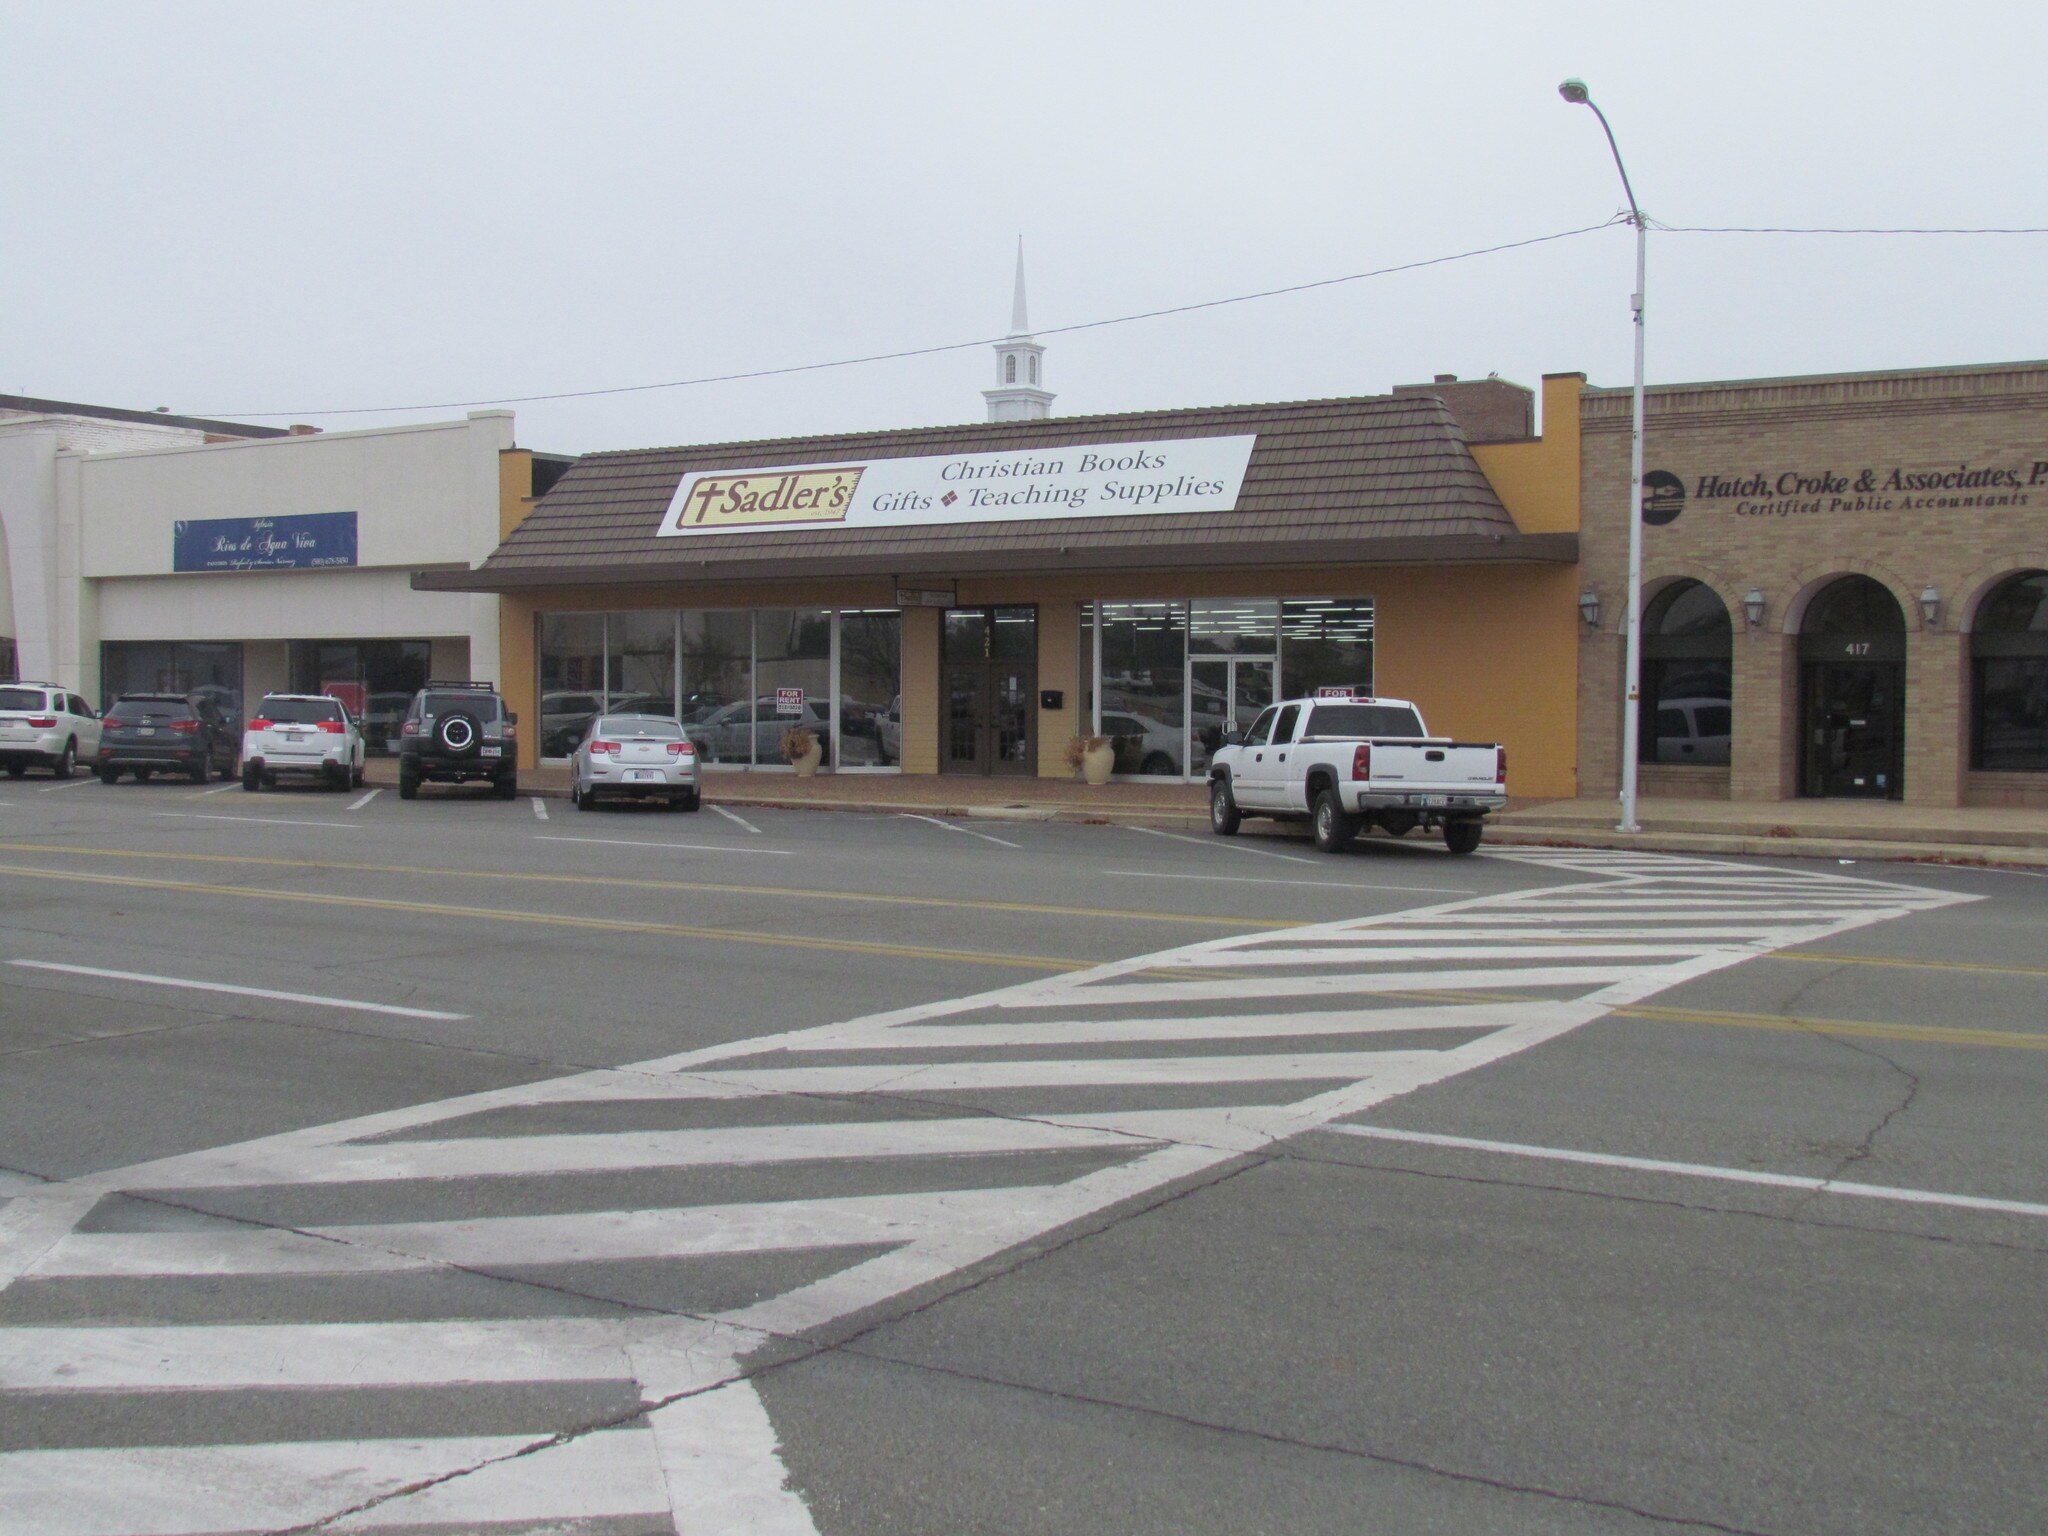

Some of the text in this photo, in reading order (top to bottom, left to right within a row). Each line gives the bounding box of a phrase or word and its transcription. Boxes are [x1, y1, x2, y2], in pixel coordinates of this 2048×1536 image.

[941, 450, 1166, 481] Christian Books
[719, 475, 848, 513] Sadler's
[872, 476, 1224, 511] Gifts Teaching Supplies
[1695, 473, 1774, 499] Hatch,
[1776, 470, 1848, 496] Croke
[1854, 469, 1876, 493] &
[1883, 465, 2023, 491] Associates,
[1736, 492, 2029, 517] Certified Public Accountants
[240, 536, 252, 551] de
[292, 531, 316, 549] Viva
[1845, 643, 1870, 655] 417
[1325, 690, 1347, 698] FOR
